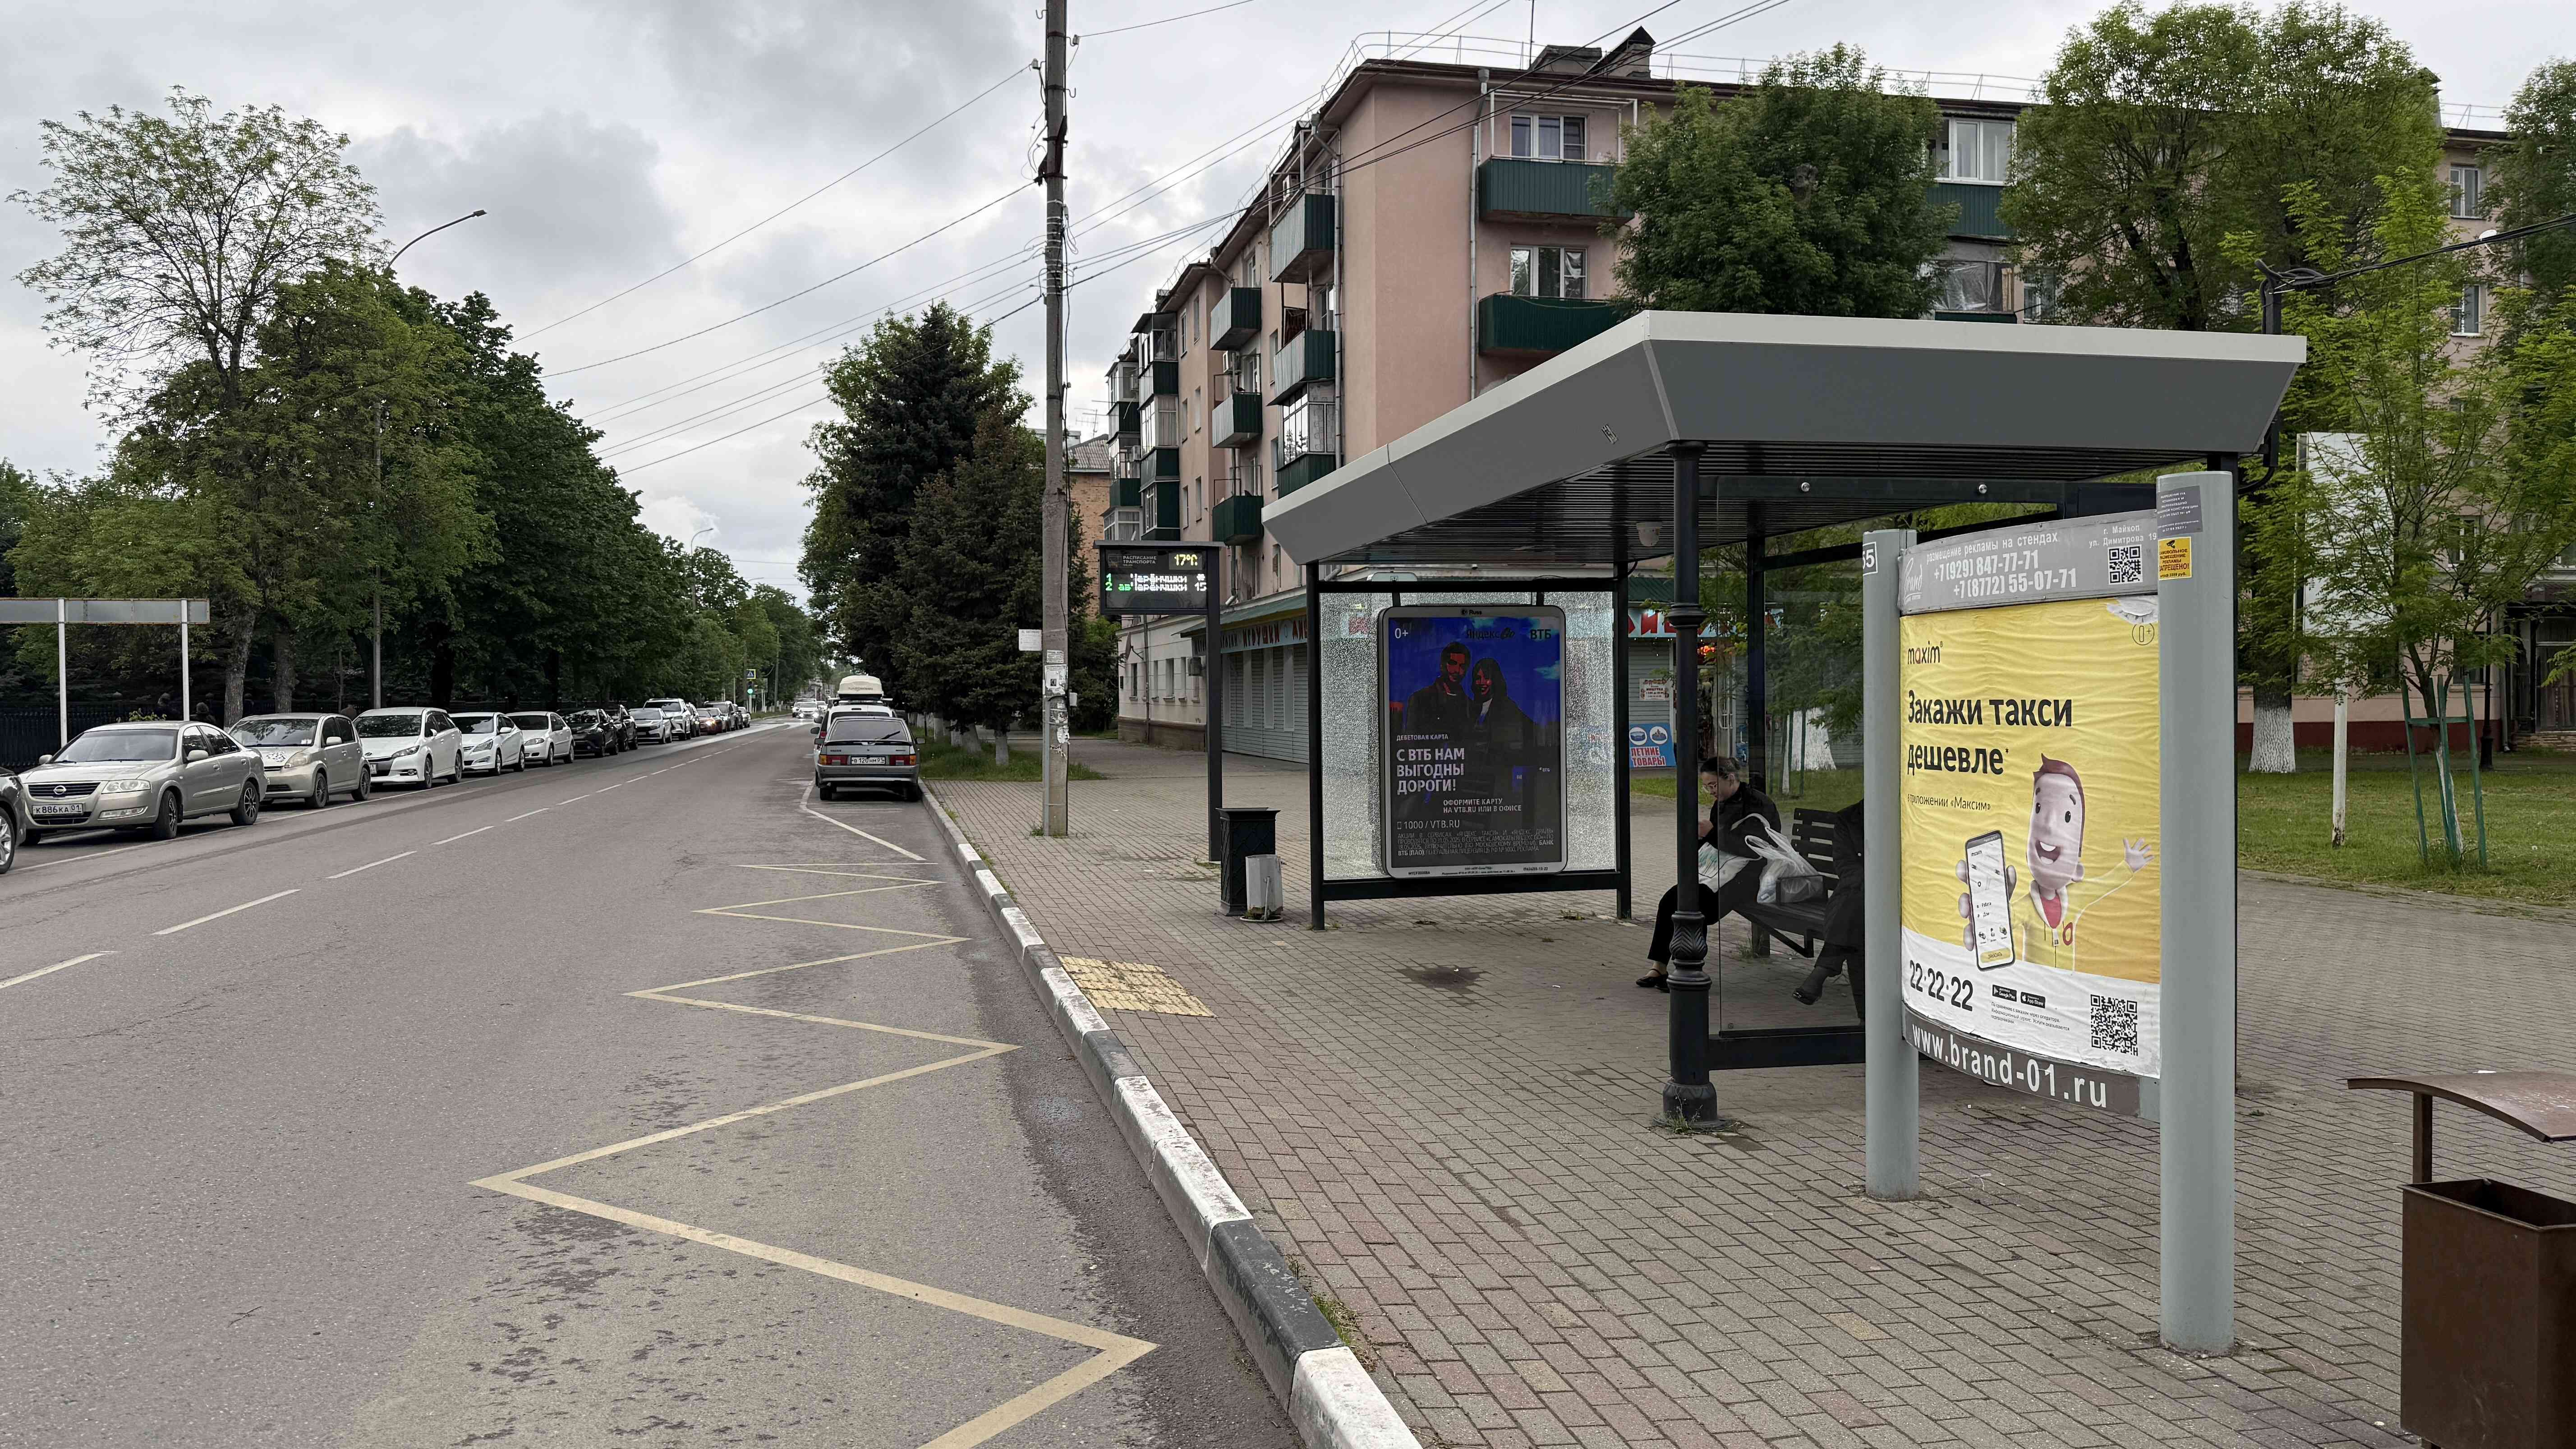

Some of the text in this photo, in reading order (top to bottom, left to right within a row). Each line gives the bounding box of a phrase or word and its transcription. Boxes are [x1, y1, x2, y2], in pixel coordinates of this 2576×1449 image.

[2112, 525, 2140, 534] Майкоп
[1927, 532, 2058, 564] размещение рекламы на стендах
[2089, 533, 2157, 548] ул. Димитрова 19
[1976, 549, 2039, 576] 847-77-71
[1105, 582, 1113, 591] 2
[1195, 582, 1207, 591] 15
[2009, 568, 2077, 593] 55-07-71
[1394, 628, 1408, 639] 0+
[1530, 629, 1552, 639] ВТБ
[1908, 690, 2072, 727] Закажи такси
[1397, 748, 1465, 761] С ВТБ НАМ
[1631, 747, 1660, 756] ЛЕТНИЕ
[1633, 756, 1665, 766] ТОВАРЫ
[1397, 764, 1464, 779] ВЫГОДНЫ
[1397, 779, 1456, 795] ДОРОГИ!
[1950, 796, 1991, 811] «Максим»
[1403, 821, 1423, 829] 1000
[1430, 820, 1460, 829] VTB.RU
[1912, 1024, 2107, 1108] www.brand-01.ru
